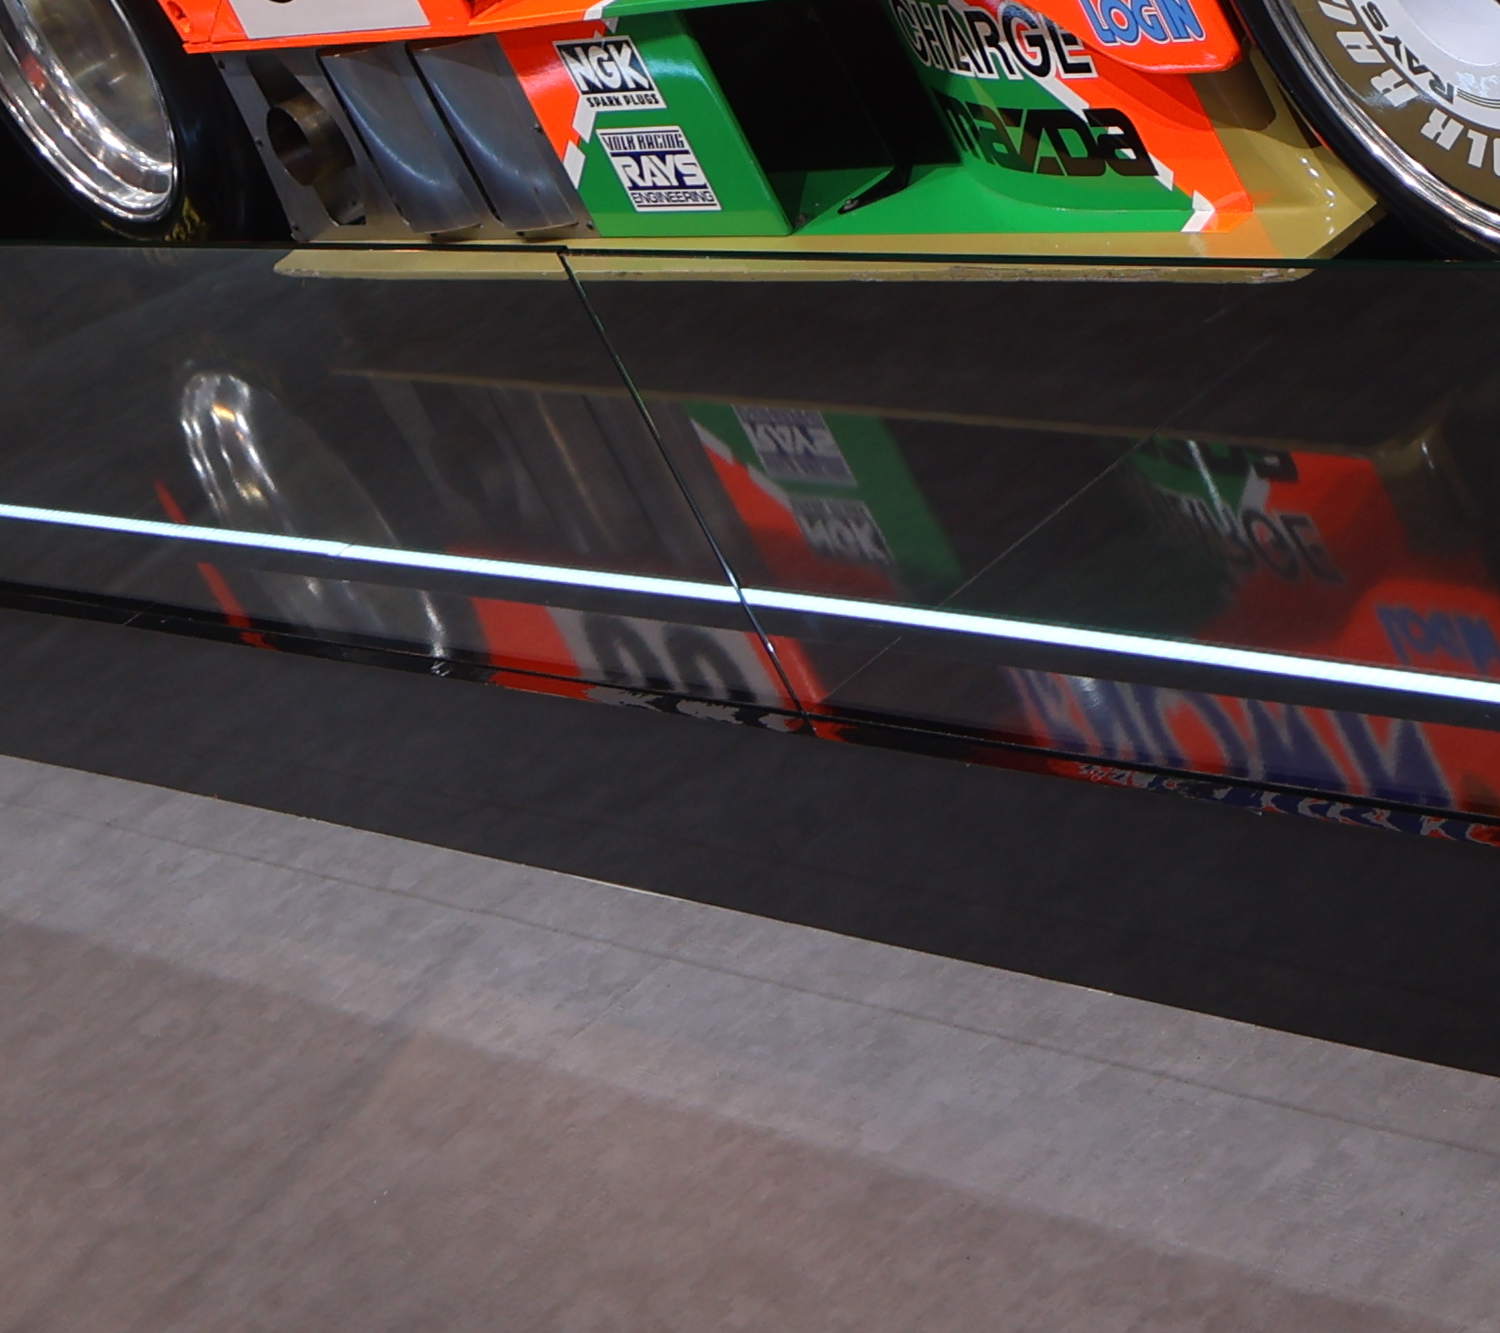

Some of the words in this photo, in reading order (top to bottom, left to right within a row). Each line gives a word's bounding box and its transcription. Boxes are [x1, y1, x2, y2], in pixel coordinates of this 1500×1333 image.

[1359, 0, 1462, 105] RAYS
[561, 42, 650, 92] NGK
[586, 95, 623, 109] SPARK
[625, 93, 660, 106] PLUGS
[601, 134, 637, 152] VOLK
[637, 133, 685, 150] RACING
[613, 154, 707, 188] RAYS
[631, 190, 715, 204] ENGINEERING
